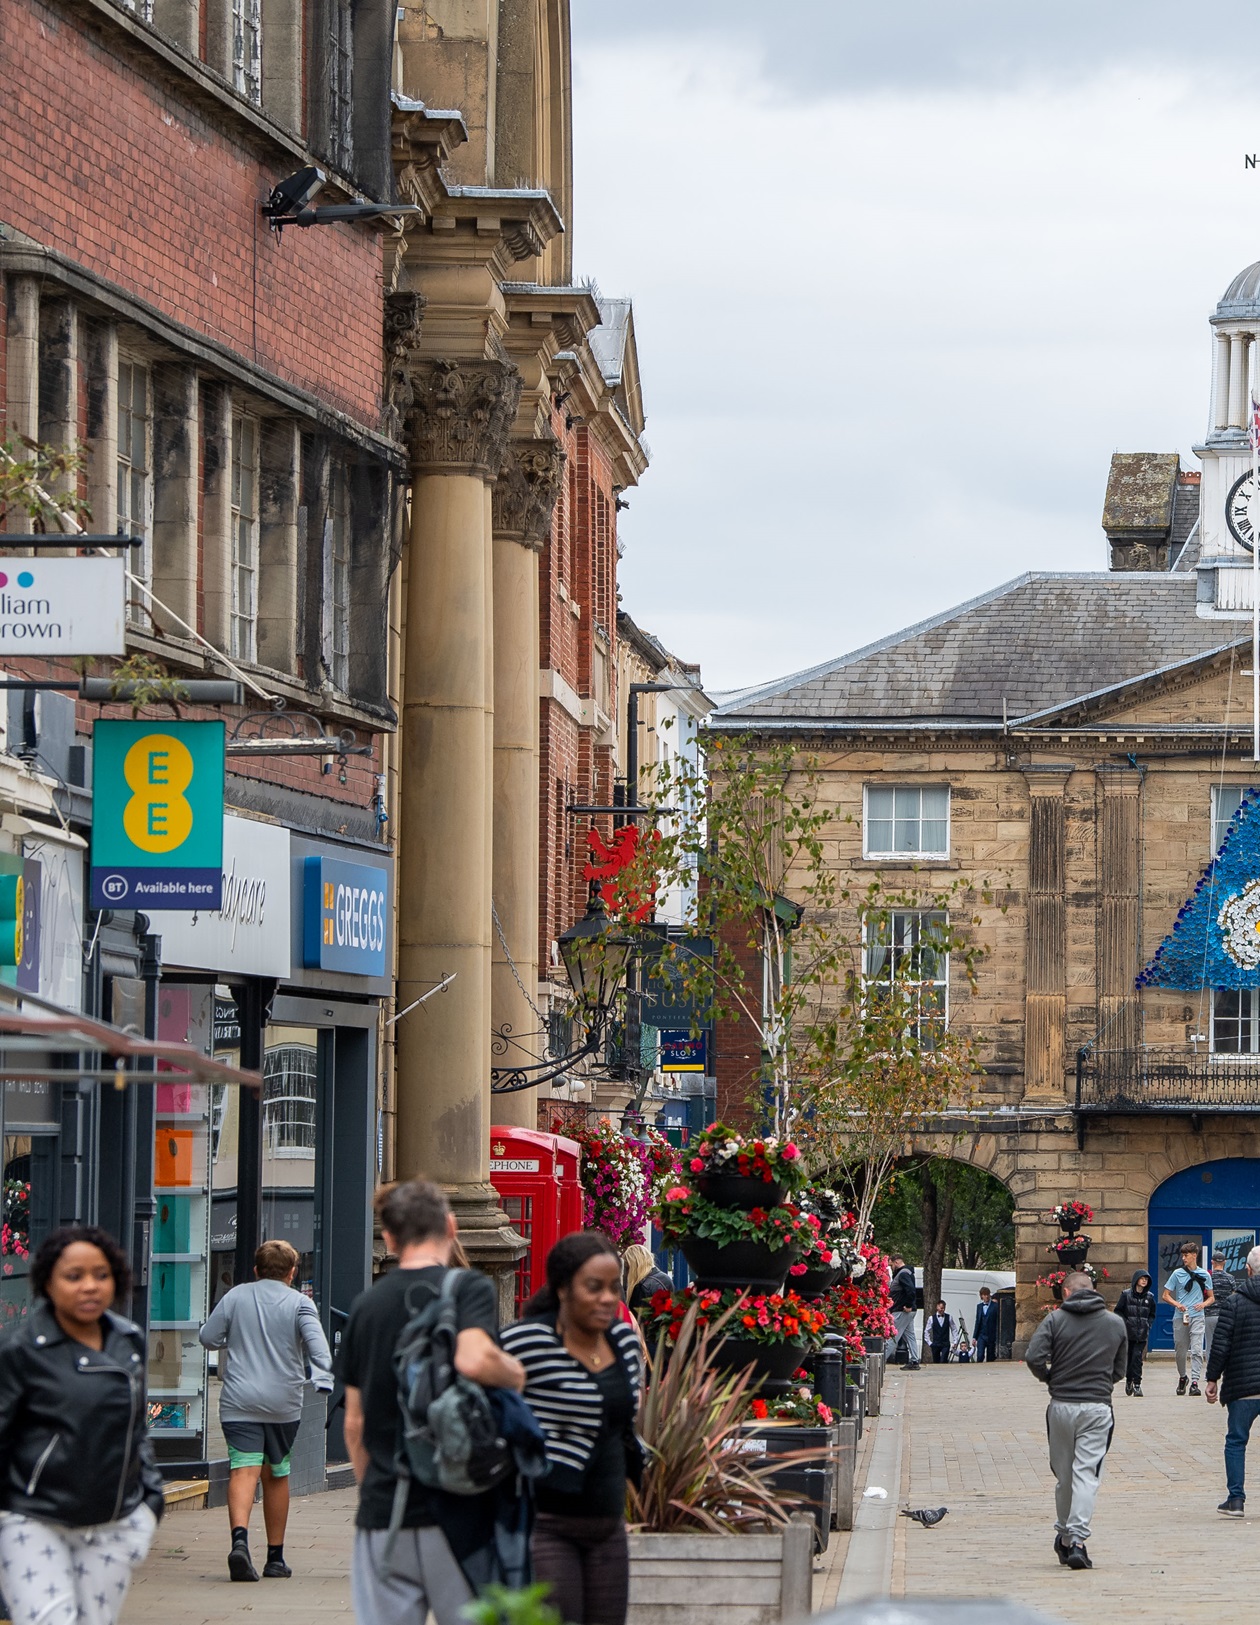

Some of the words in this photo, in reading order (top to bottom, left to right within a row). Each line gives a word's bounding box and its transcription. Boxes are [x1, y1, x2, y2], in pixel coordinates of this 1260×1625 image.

[1245, 154, 1256, 169] N
[0, 622, 62, 639] rown
[107, 882, 123, 893] BT
[134, 881, 186, 894] Available
[188, 881, 214, 894] here
[335, 883, 385, 952] GREGGS
[1221, 1245, 1241, 1259] AFE
[1224, 1257, 1247, 1272] PAC
